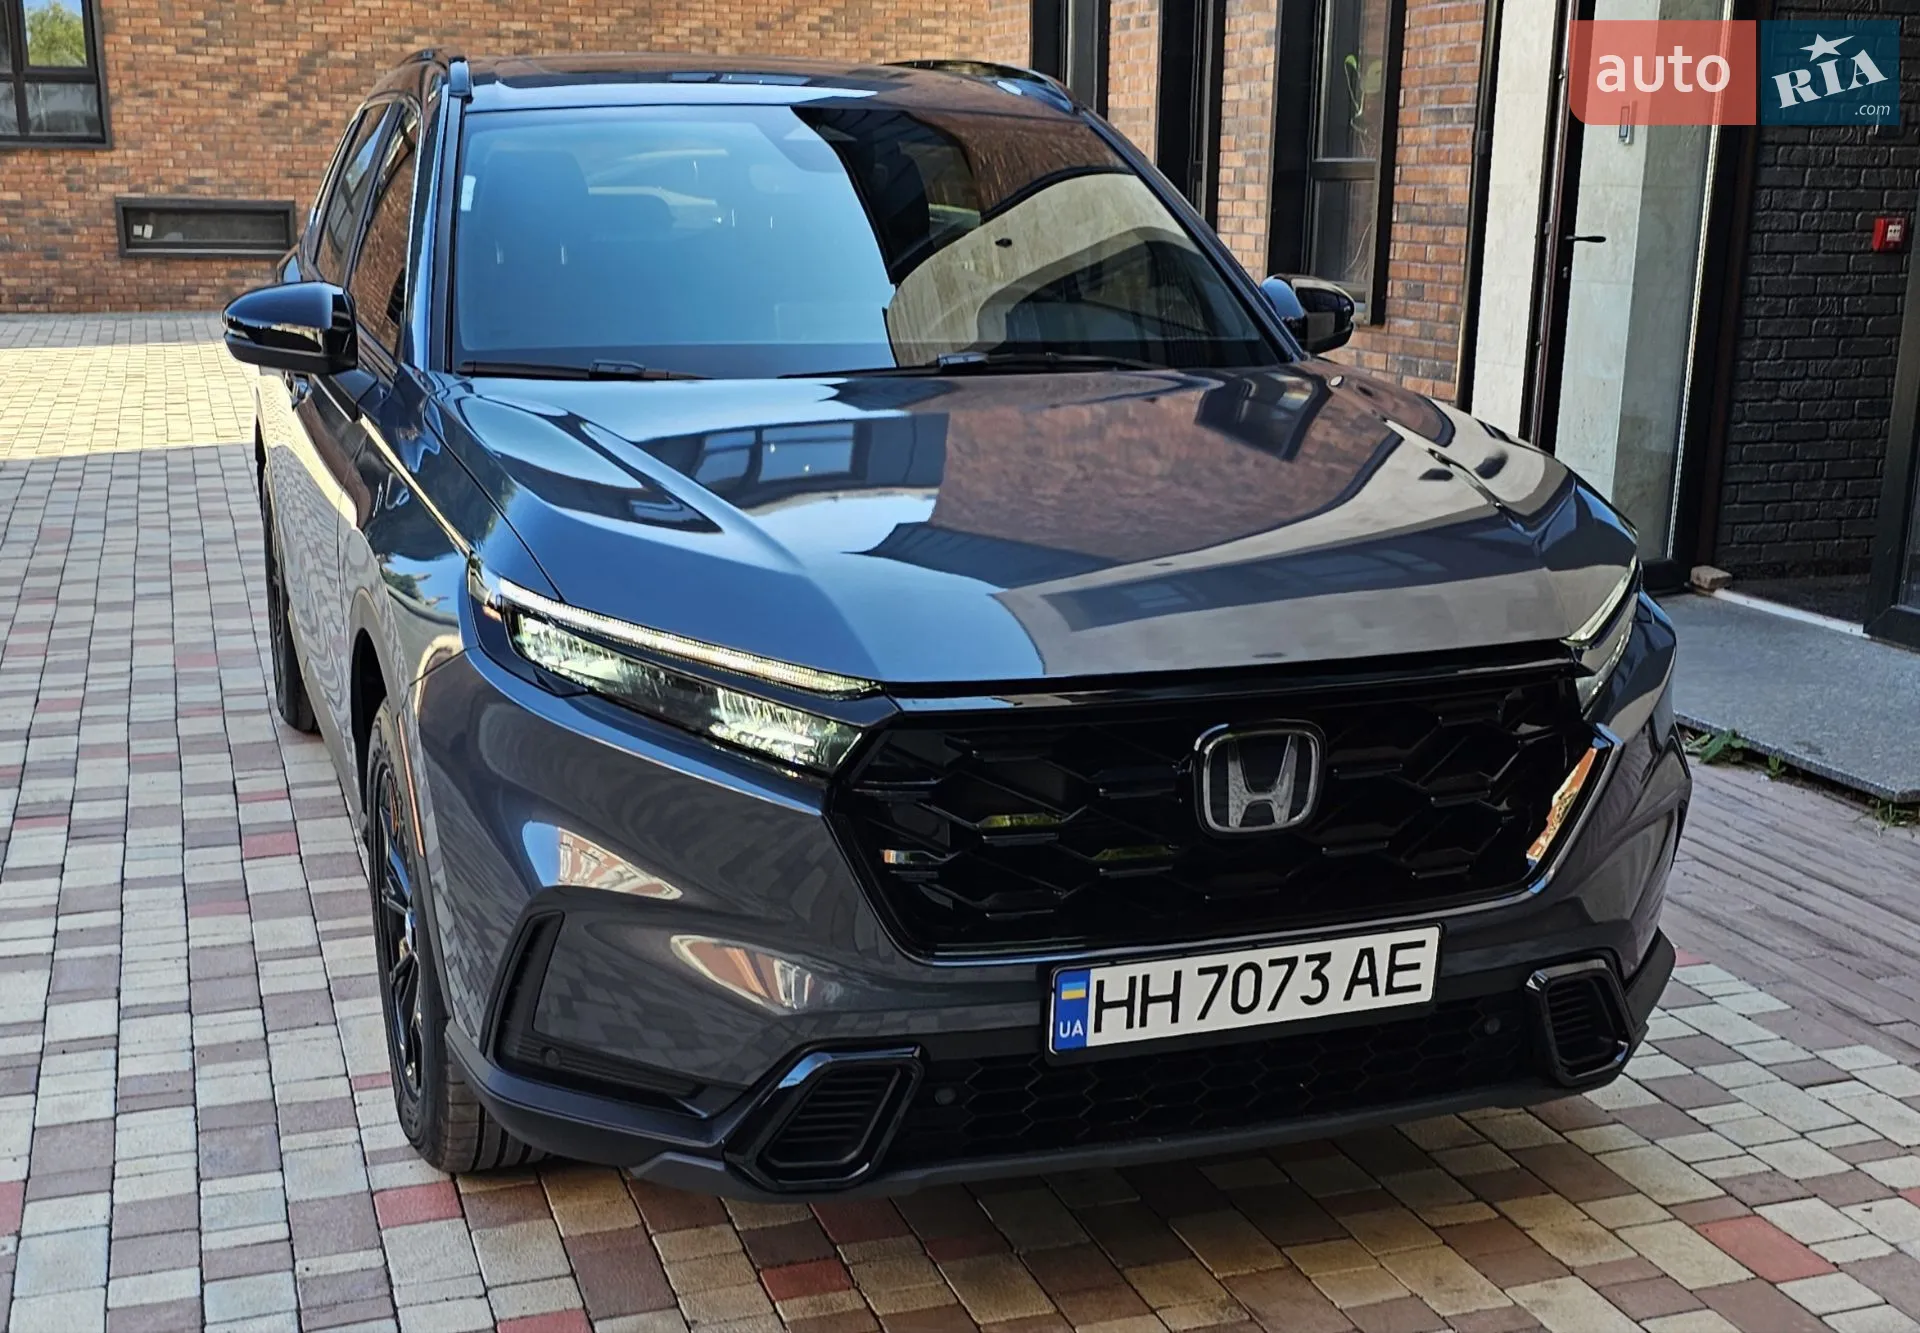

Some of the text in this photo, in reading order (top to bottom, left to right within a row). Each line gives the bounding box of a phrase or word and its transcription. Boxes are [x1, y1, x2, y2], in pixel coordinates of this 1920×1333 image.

[1092, 939, 1427, 1034] HH 7073 AE
[1060, 1019, 1084, 1038] UA
